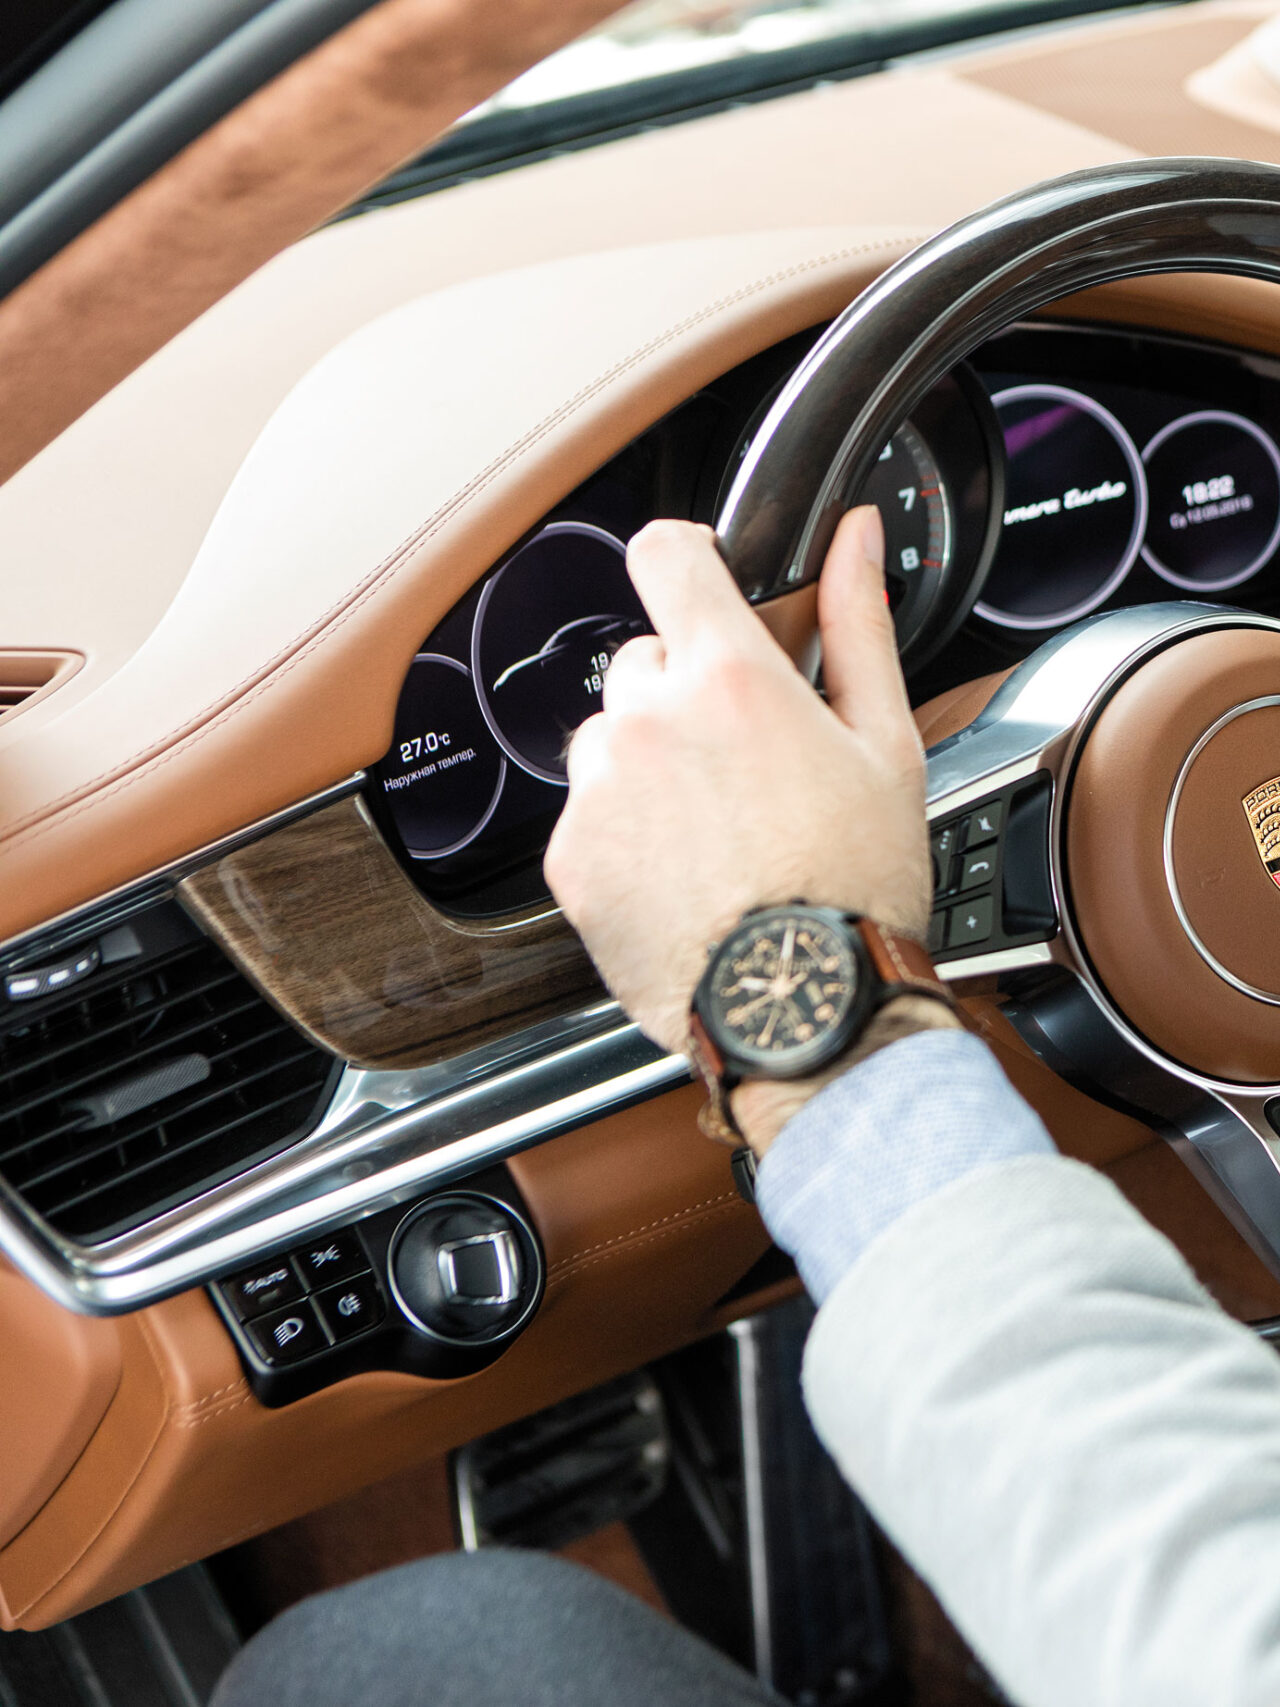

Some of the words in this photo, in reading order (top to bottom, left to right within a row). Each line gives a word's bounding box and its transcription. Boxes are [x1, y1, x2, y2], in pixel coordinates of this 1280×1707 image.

[898, 487, 916, 511] 7
[901, 547, 919, 571] 8
[383, 763, 437, 792] Наружная
